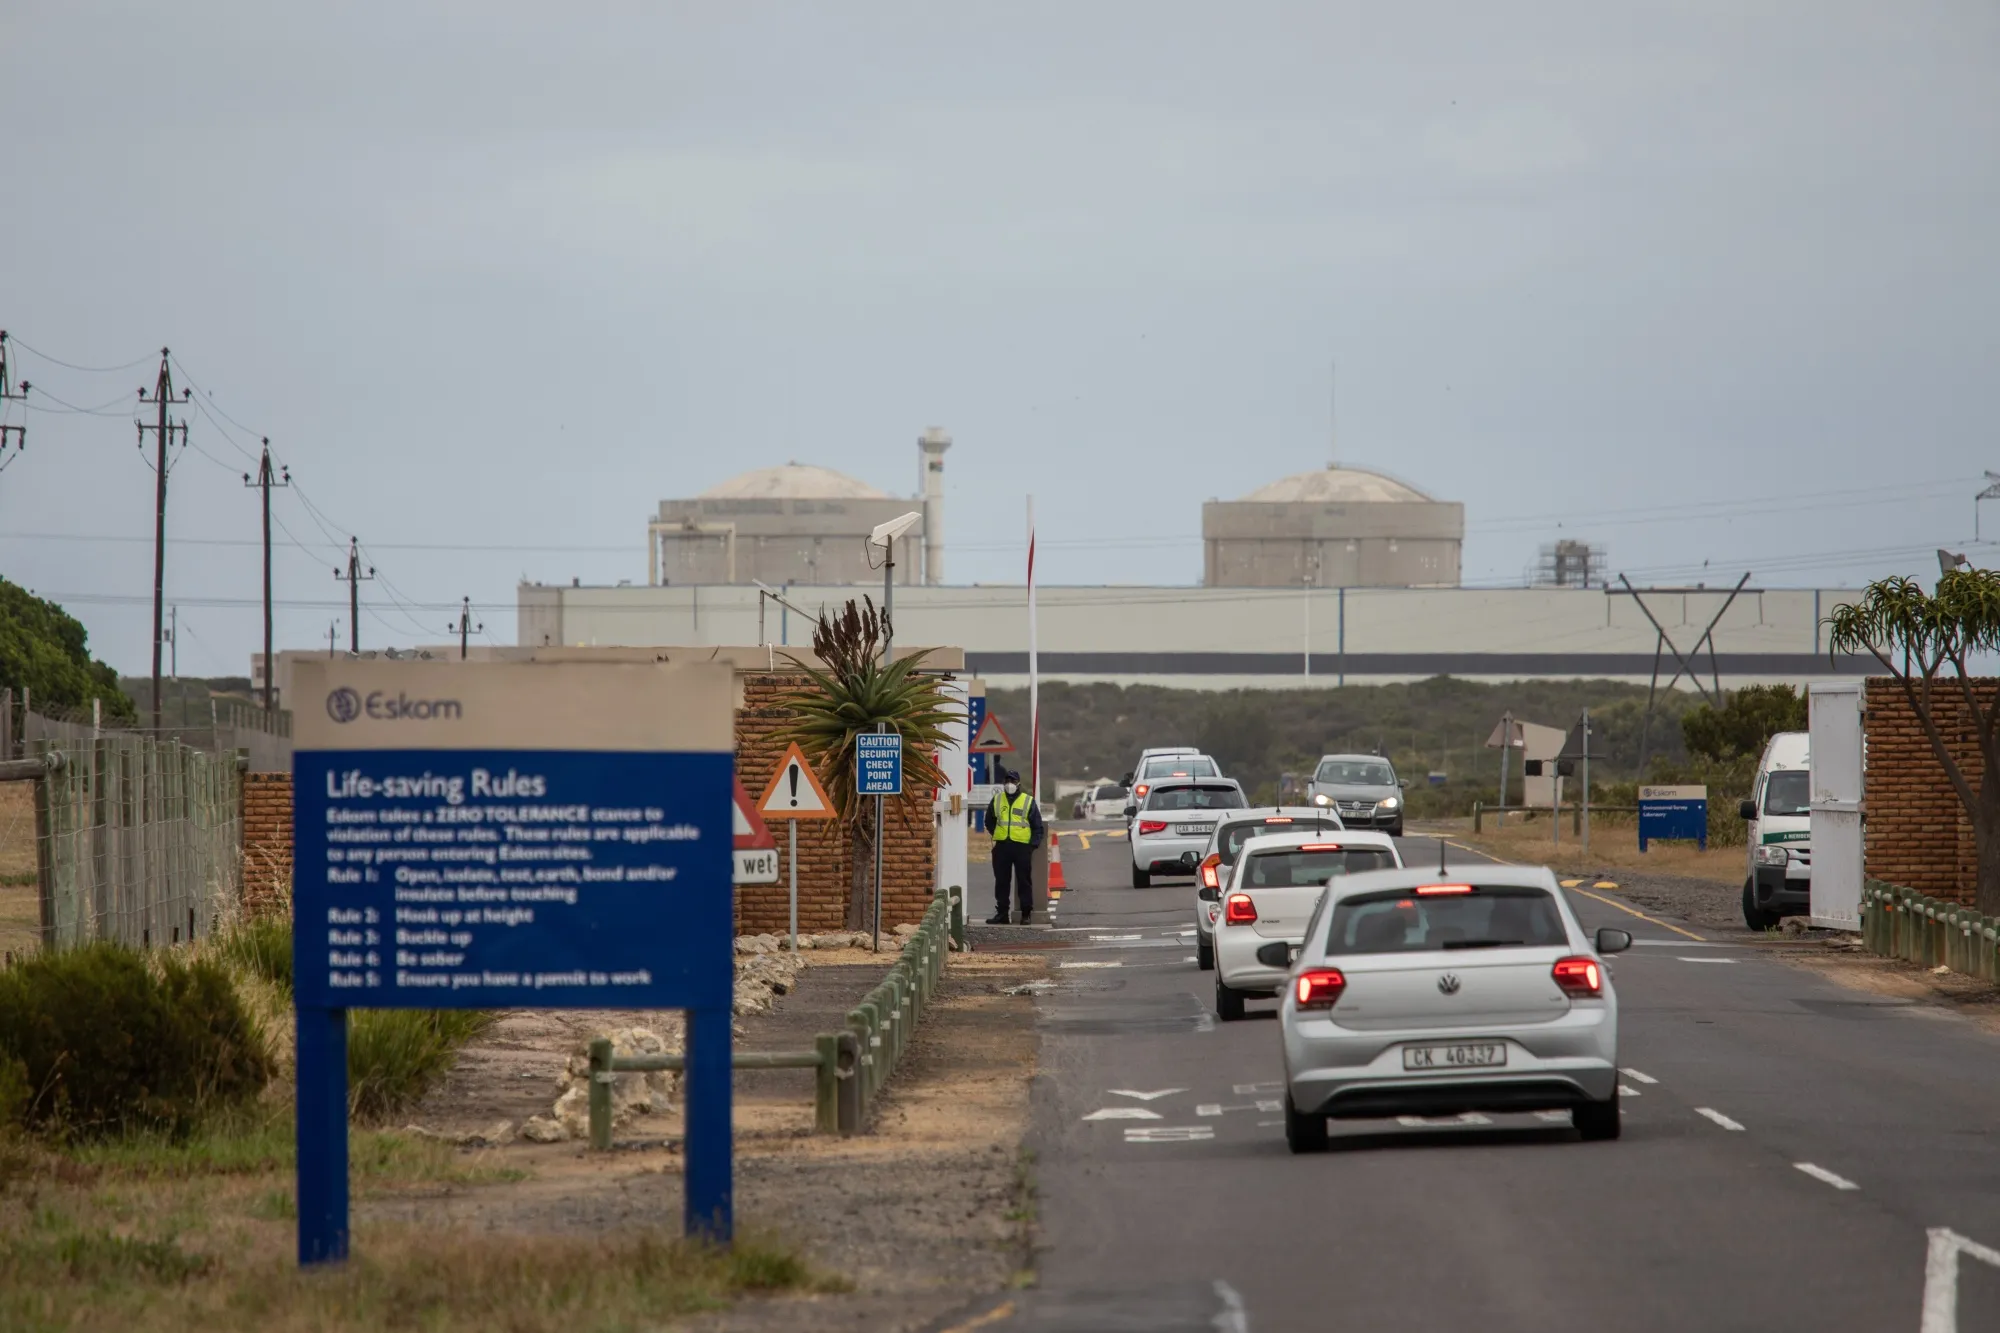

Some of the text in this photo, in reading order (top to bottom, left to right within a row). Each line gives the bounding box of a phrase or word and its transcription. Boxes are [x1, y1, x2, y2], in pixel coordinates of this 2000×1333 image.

[366, 690, 462, 720] Eskom
[860, 736, 899, 746] CAUTION
[860, 750, 899, 758] SECURITY
[865, 760, 894, 769] CHECK
[867, 771, 892, 780] POINT
[327, 769, 546, 804] Life-saving Rules
[866, 782, 893, 791] AHEAD
[327, 805, 663, 823] Eskom takes a ZERO TOLERANCE stance to
[327, 826, 390, 842] violation
[394, 825, 410, 842] of
[413, 826, 455, 842] these
[505, 826, 550, 841] These
[551, 825, 591, 841] rules
[594, 827, 620, 841] are
[623, 824, 700, 844] applicable
[327, 847, 343, 862] to
[346, 848, 373, 863] any
[376, 848, 428, 864] person
[431, 846, 496, 864] entering
[499, 845, 553, 861] Eskom
[743, 854, 772, 875] wet
[328, 867, 360, 883] Rule
[582, 865, 624, 882] bond
[395, 886, 577, 904] insulate before touching
[328, 908, 361, 924] Rule
[395, 908, 438, 923] Hook
[441, 911, 462, 926] up
[464, 909, 480, 923] at
[483, 907, 534, 926] height
[328, 929, 361, 945] Rule
[396, 929, 447, 945] Buckle
[450, 932, 472, 947] up
[329, 951, 362, 967] Rule
[396, 950, 417, 966] Be
[419, 950, 465, 966] sober
[329, 972, 362, 987] Rule
[397, 971, 449, 987] Ensure
[451, 974, 480, 989] you
[483, 970, 518, 986] have
[522, 972, 533, 985] a
[535, 970, 587, 989] permit
[590, 970, 608, 985] to
[610, 969, 651, 985] work
[1414, 1045, 1495, 1066] CK 40337
